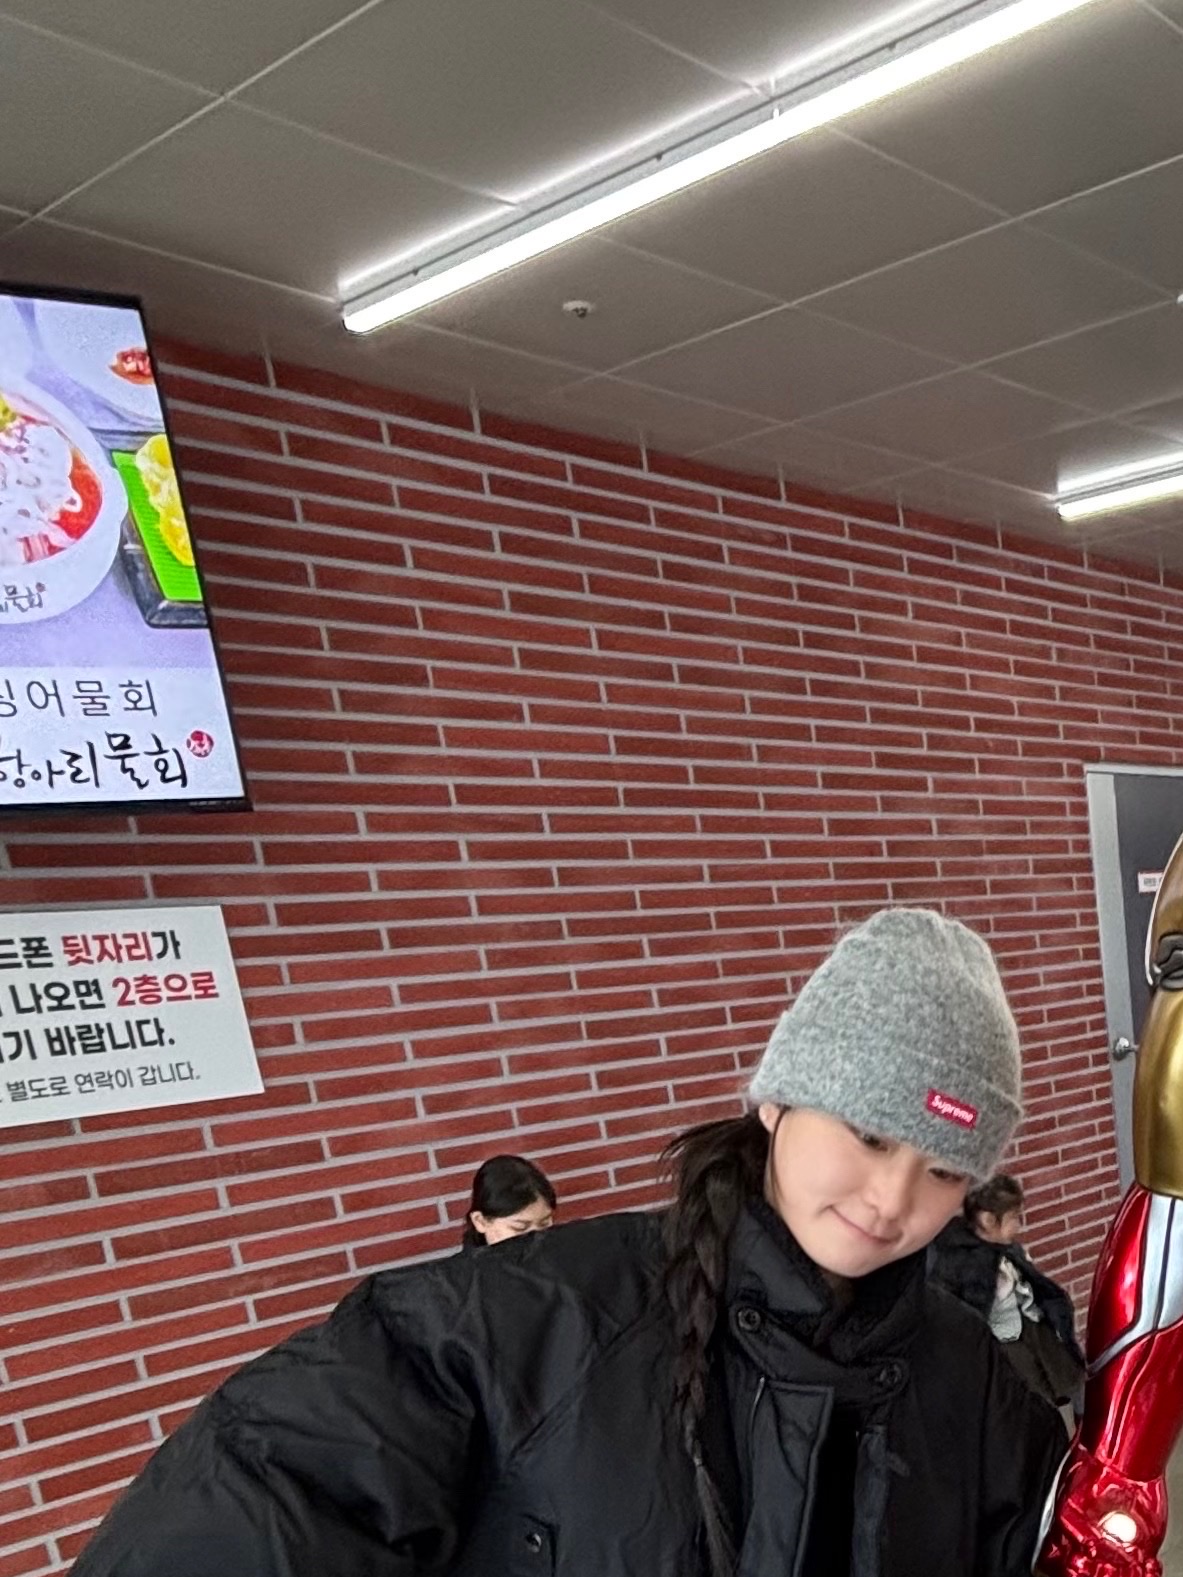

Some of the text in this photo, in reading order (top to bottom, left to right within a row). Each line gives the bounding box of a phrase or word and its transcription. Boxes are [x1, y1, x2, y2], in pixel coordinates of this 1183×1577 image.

[61, 930, 182, 967] 뒷자리가
[9, 978, 106, 1014] 나오면
[112, 970, 220, 1008] 2층으로
[44, 1017, 176, 1057] 바랍니다.
[6, 1060, 201, 1103] 별도로 연락이 갑니다.
[931, 1094, 974, 1123] Supreme
